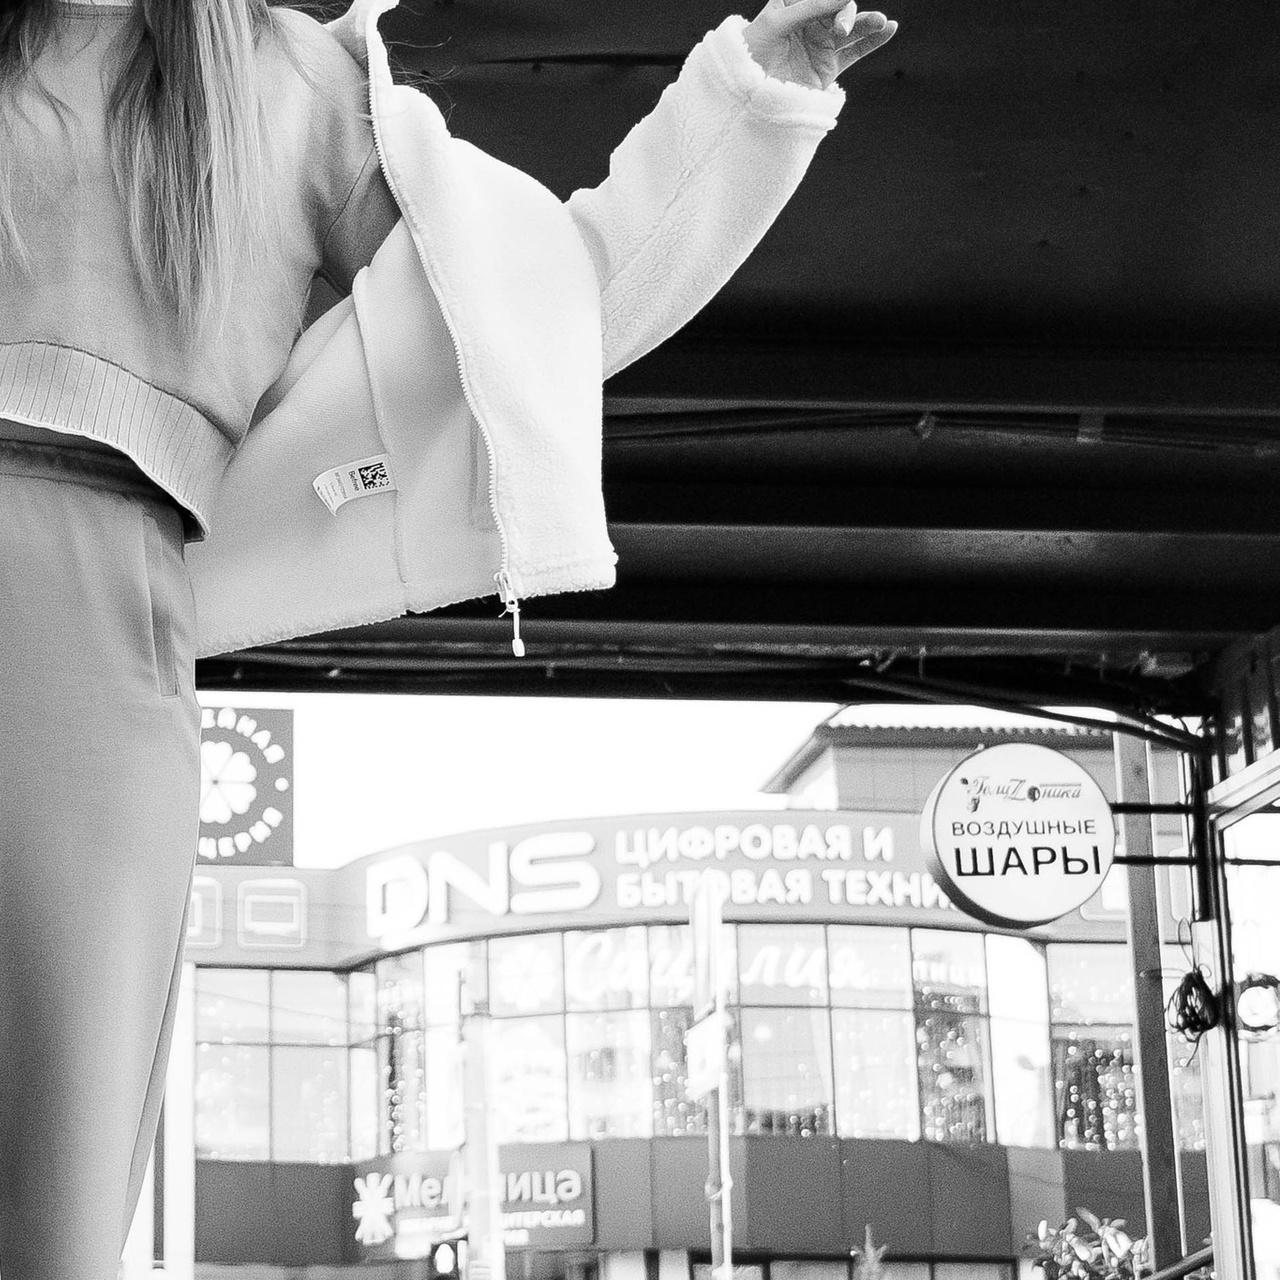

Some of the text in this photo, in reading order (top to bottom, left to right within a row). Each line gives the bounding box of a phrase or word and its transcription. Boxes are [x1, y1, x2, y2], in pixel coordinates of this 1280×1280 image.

[615, 823, 894, 869] ЦИФРОВАЯ И
[951, 819, 1097, 839] ВОЗДУШНЫЕ
[954, 845, 1101, 877] ШАРЫ
[366, 831, 601, 941] DNS
[821, 869, 956, 910] ТЕХНИ
[566, 933, 870, 1002] Сицлия
[394, 1169, 582, 1208] Меица
